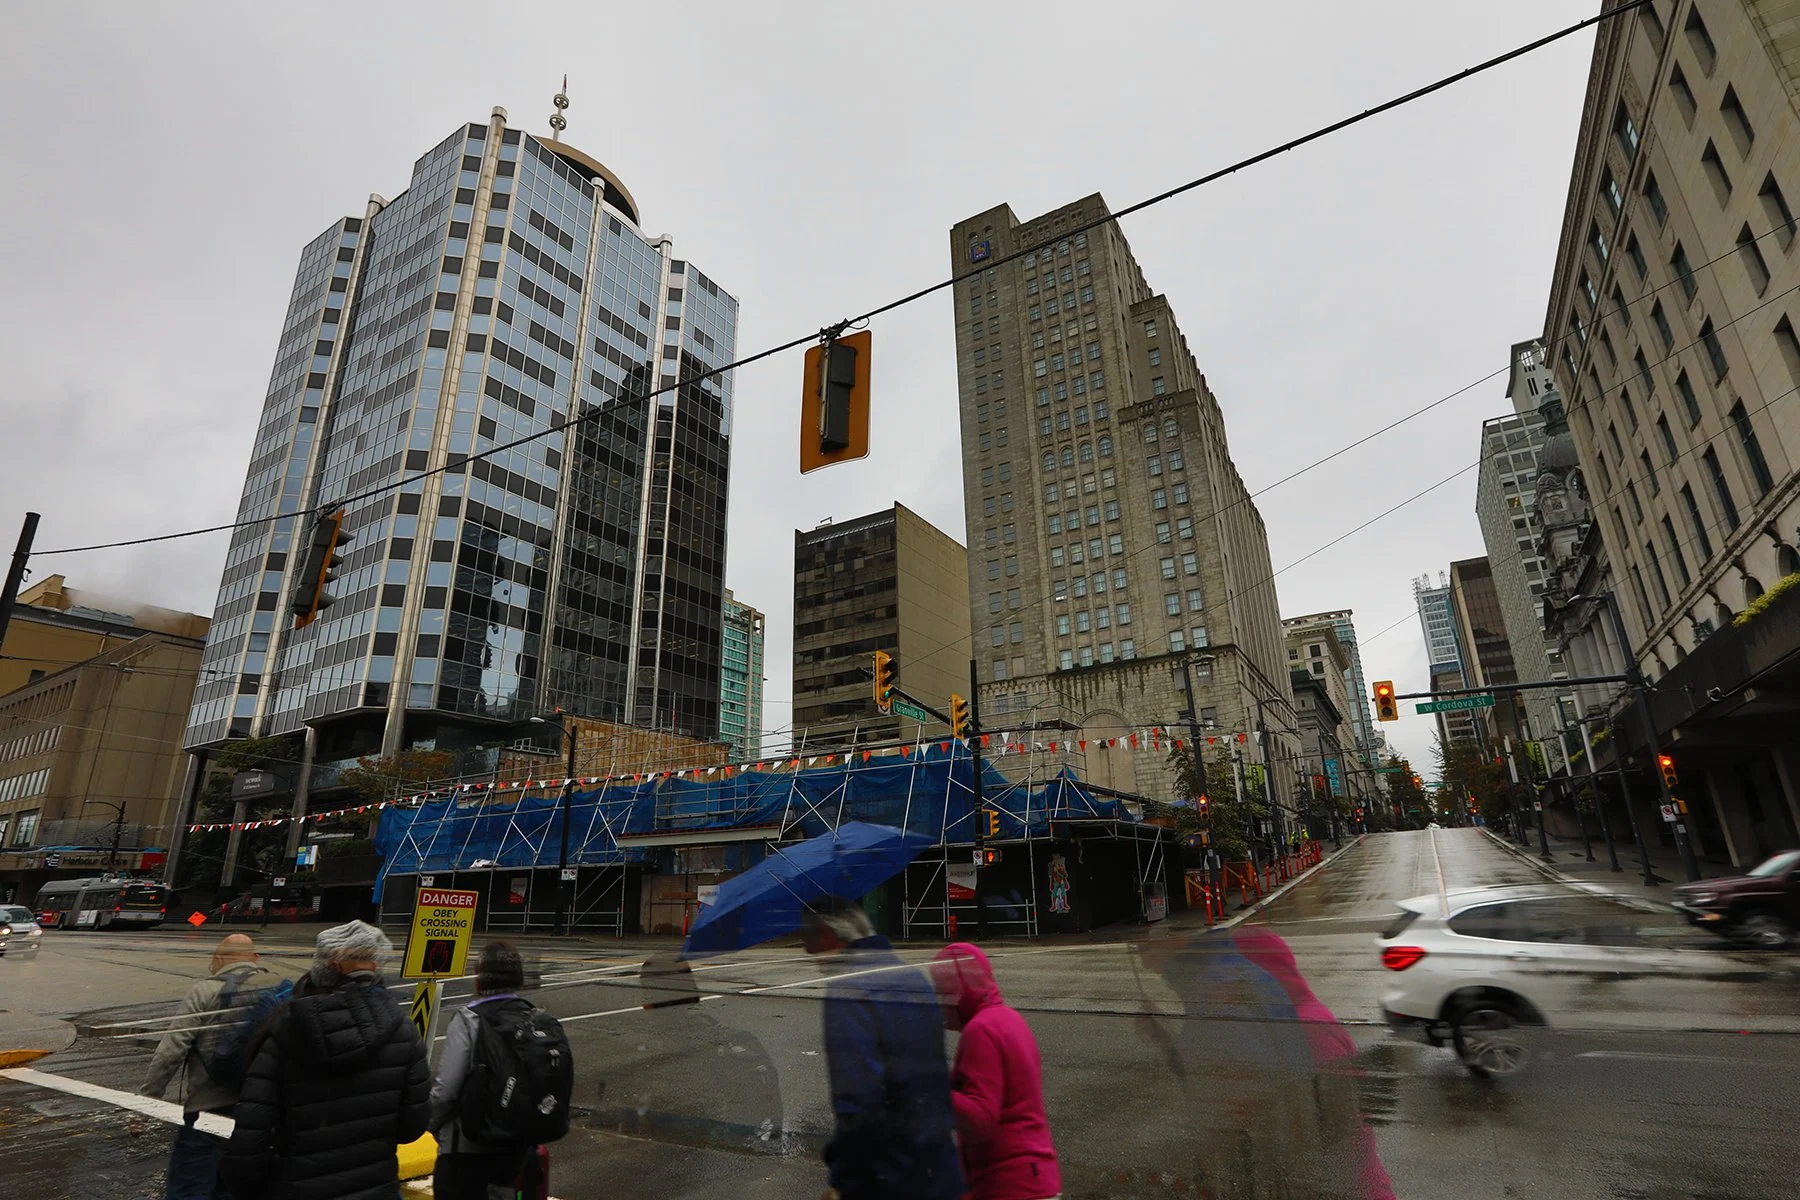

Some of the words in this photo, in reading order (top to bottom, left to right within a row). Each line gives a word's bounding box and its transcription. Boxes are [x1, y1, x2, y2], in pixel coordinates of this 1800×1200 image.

[1436, 700, 1473, 710] Cordova
[1477, 697, 1486, 705] St
[896, 703, 918, 718] Granville
[919, 711, 925, 720] St
[422, 893, 473, 906] DANGER
[433, 909, 458, 918] OBEY
[420, 918, 467, 928] CROSSING
[425, 928, 459, 937] SIGNAL
